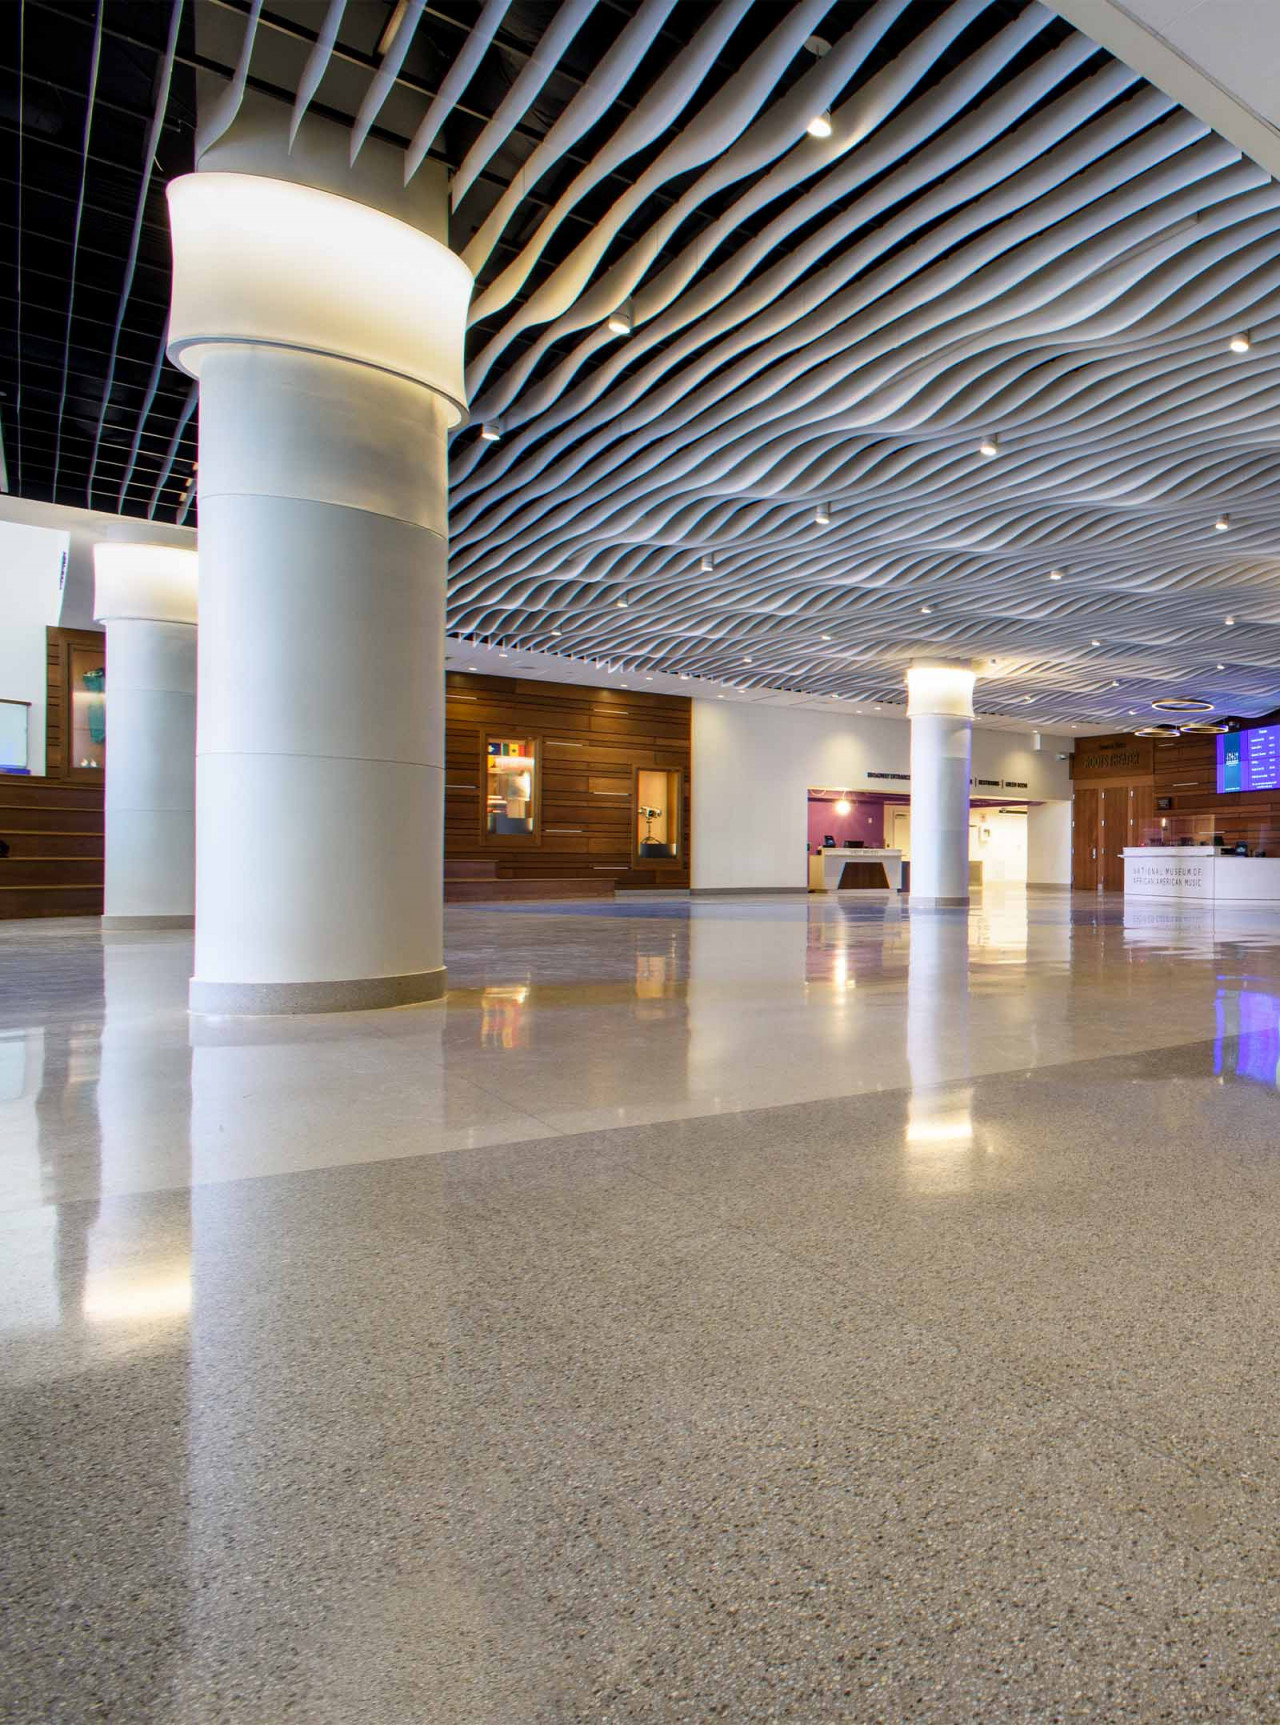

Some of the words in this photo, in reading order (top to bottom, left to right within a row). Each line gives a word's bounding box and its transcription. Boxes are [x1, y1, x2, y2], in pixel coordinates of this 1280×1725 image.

[1132, 866, 1163, 876] NATONAL
[1165, 867, 1192, 876] MUSEUM
[1193, 868, 1202, 876] OF
[1156, 877, 1183, 887] AMERICAN
[1184, 878, 1202, 887] MUSIC
